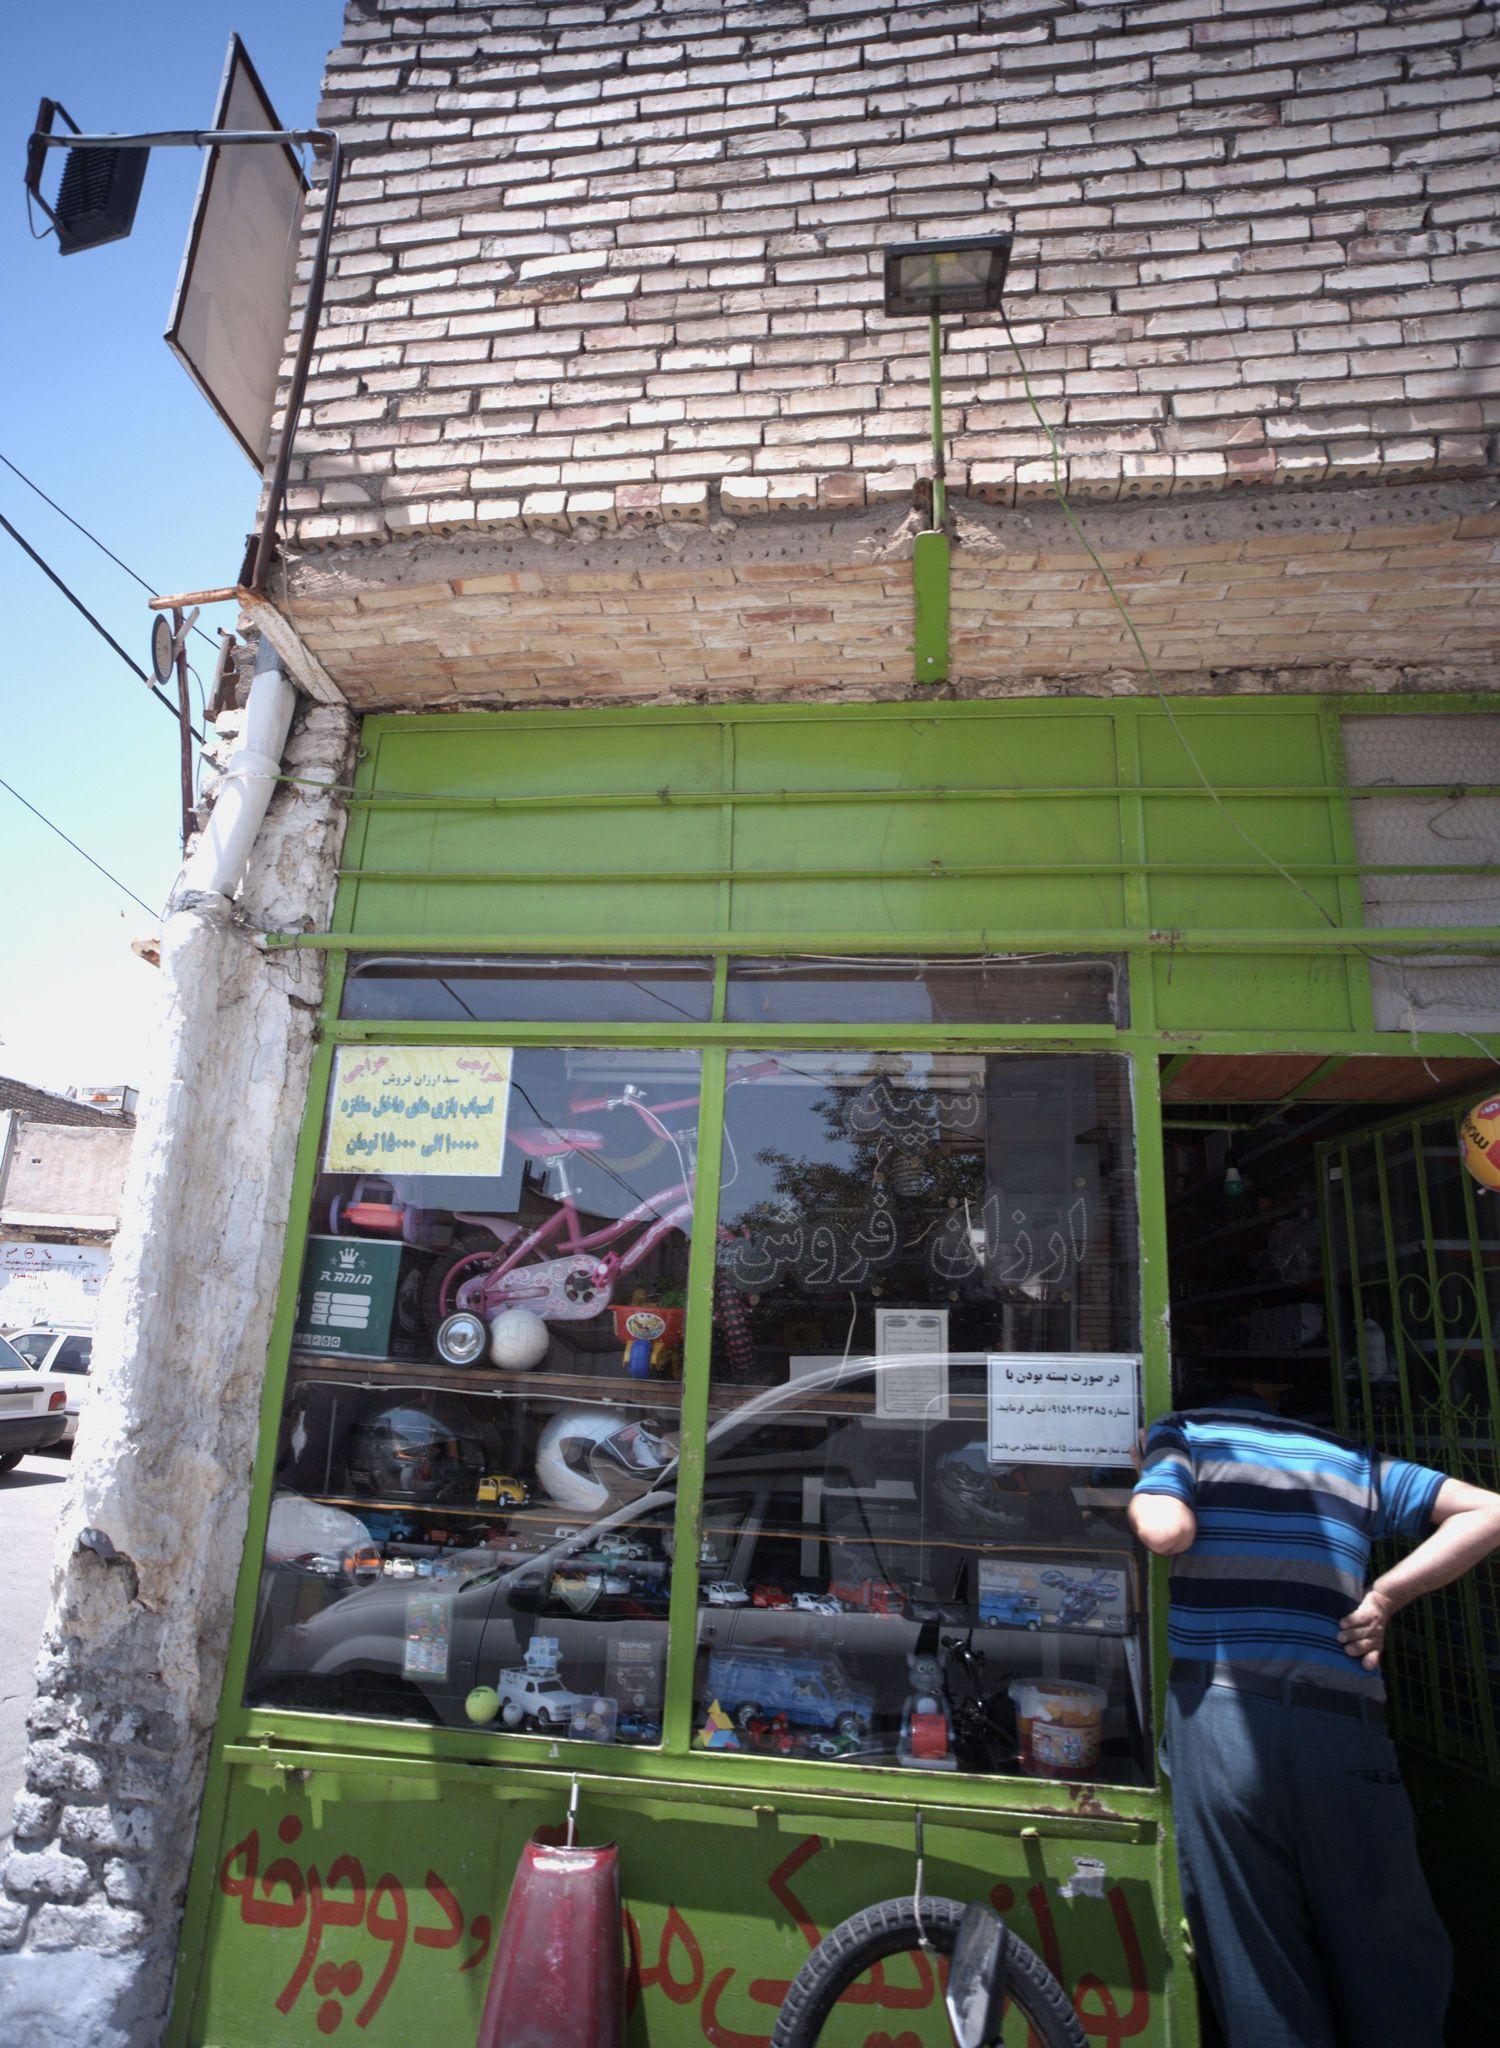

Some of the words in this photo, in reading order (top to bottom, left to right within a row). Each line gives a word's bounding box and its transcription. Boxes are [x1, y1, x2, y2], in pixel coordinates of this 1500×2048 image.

[382, 1072, 412, 1086] فروش
[413, 1073, 441, 1086] ارزان
[442, 1075, 460, 1085] سید
[340, 1094, 372, 1118] مغازه
[371, 1094, 405, 1118] داخل
[405, 1095, 431, 1119] های
[430, 1096, 459, 1119] بازی
[459, 1095, 495, 1119] اسباب
[850, 1083, 980, 1146] سید
[345, 1131, 380, 1156] تومان
[420, 1133, 444, 1157] الی
[731, 1191, 898, 1284] فروش
[931, 1195, 1088, 1283] ارزان
[1005, 1368, 1014, 1383] با
[1016, 1373, 1043, 1384] بودن
[1045, 1372, 1068, 1385] بسته
[1071, 1373, 1104, 1386] صورت
[1106, 1374, 1120, 1386] در
[1026, 1404, 1046, 1415] تماس
[1108, 1407, 1131, 1418] شماره
[219, 1813, 464, 2036] دوچرخه
